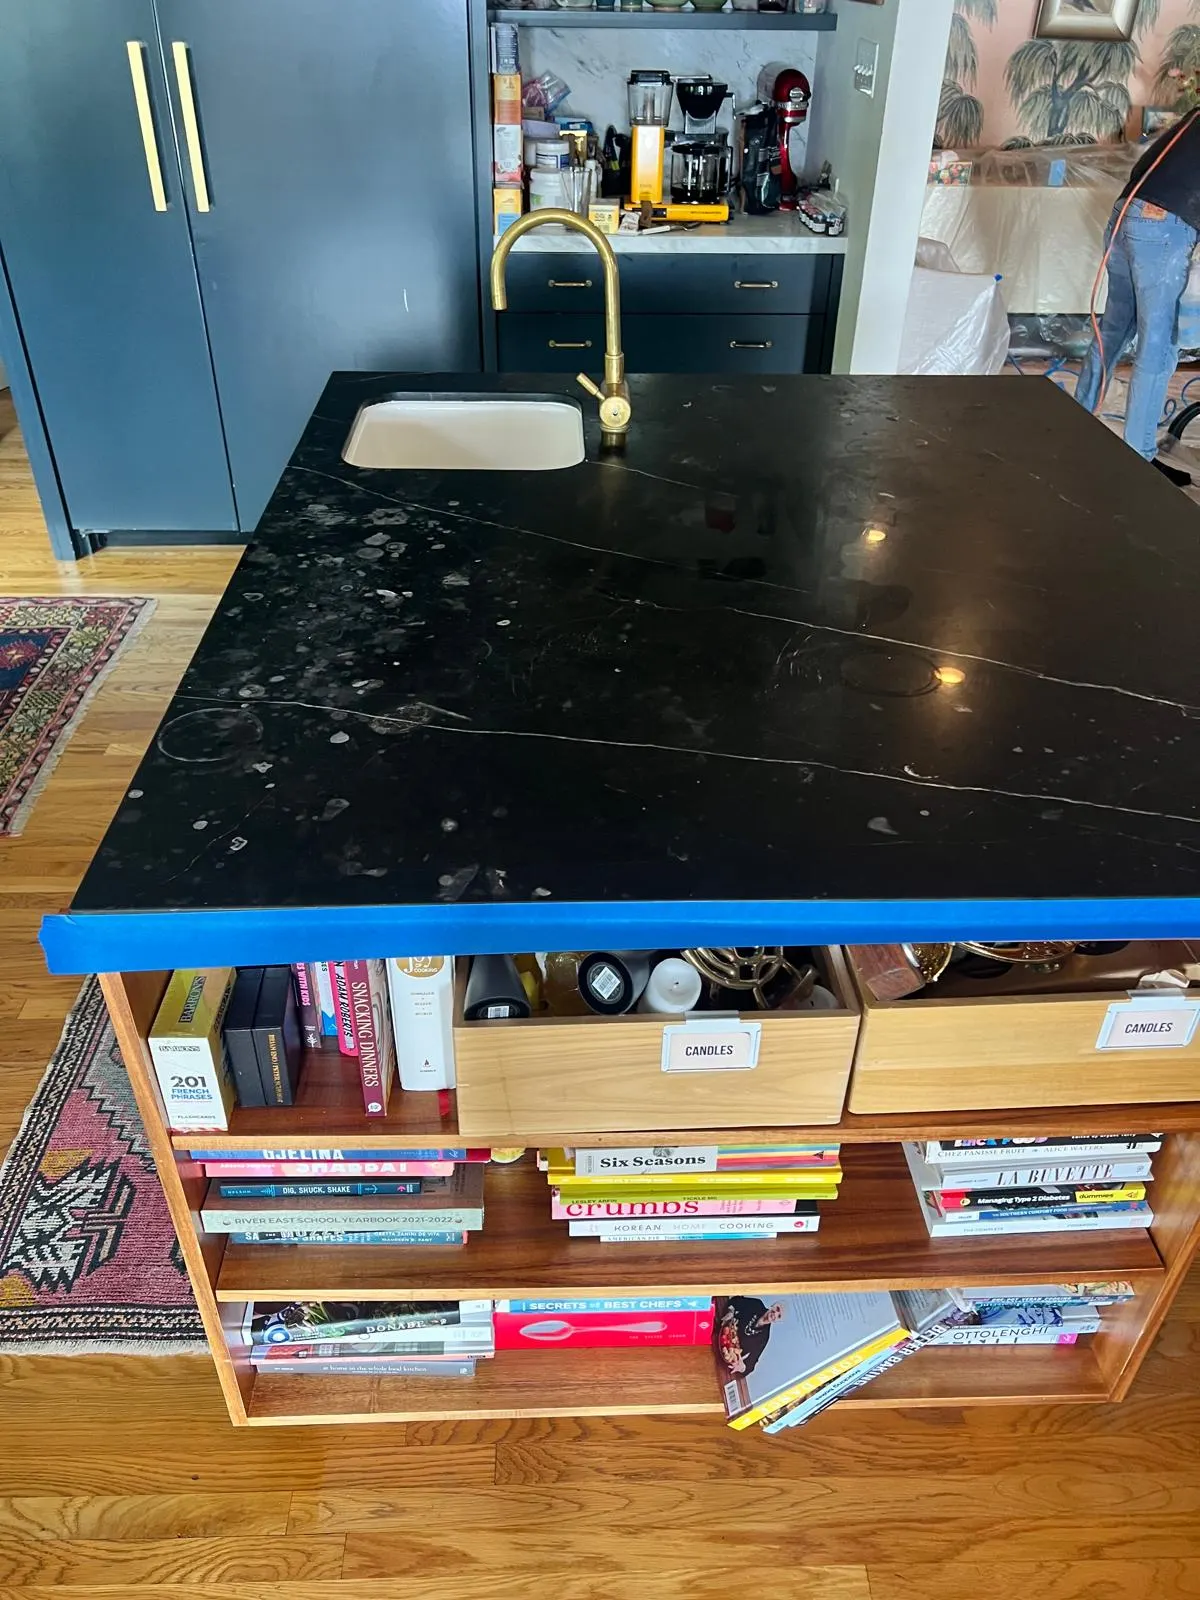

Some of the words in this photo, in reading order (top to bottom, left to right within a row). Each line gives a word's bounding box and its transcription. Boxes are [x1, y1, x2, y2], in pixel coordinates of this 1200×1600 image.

[300, 989, 311, 1006] KIDS
[351, 981, 373, 1039] SNACKING
[1124, 1022, 1173, 1033] CANDLES
[685, 1045, 734, 1056] CANDLES
[359, 1041, 379, 1087] DINNERS
[170, 1075, 207, 1088] 201
[263, 1149, 344, 1160] GJELINA
[600, 1157, 628, 1168] Six
[632, 1155, 706, 1167] Seasons
[997, 1171, 1018, 1186] LA
[1028, 1164, 1113, 1183] BUVETTE
[327, 1185, 350, 1193] SHAKE
[566, 1200, 699, 1216] crumbs
[614, 1224, 662, 1232] KOREAN
[719, 1222, 774, 1230] COOKING
[529, 1302, 587, 1310] SECRETS
[604, 1301, 636, 1309] BEST
[639, 1300, 682, 1308] CHEFS
[366, 1320, 427, 1333] DONABE
[898, 1323, 946, 1355] BETTER
[953, 1327, 1049, 1340] OTTOLENGHI
[854, 1355, 902, 1386] BAKING
